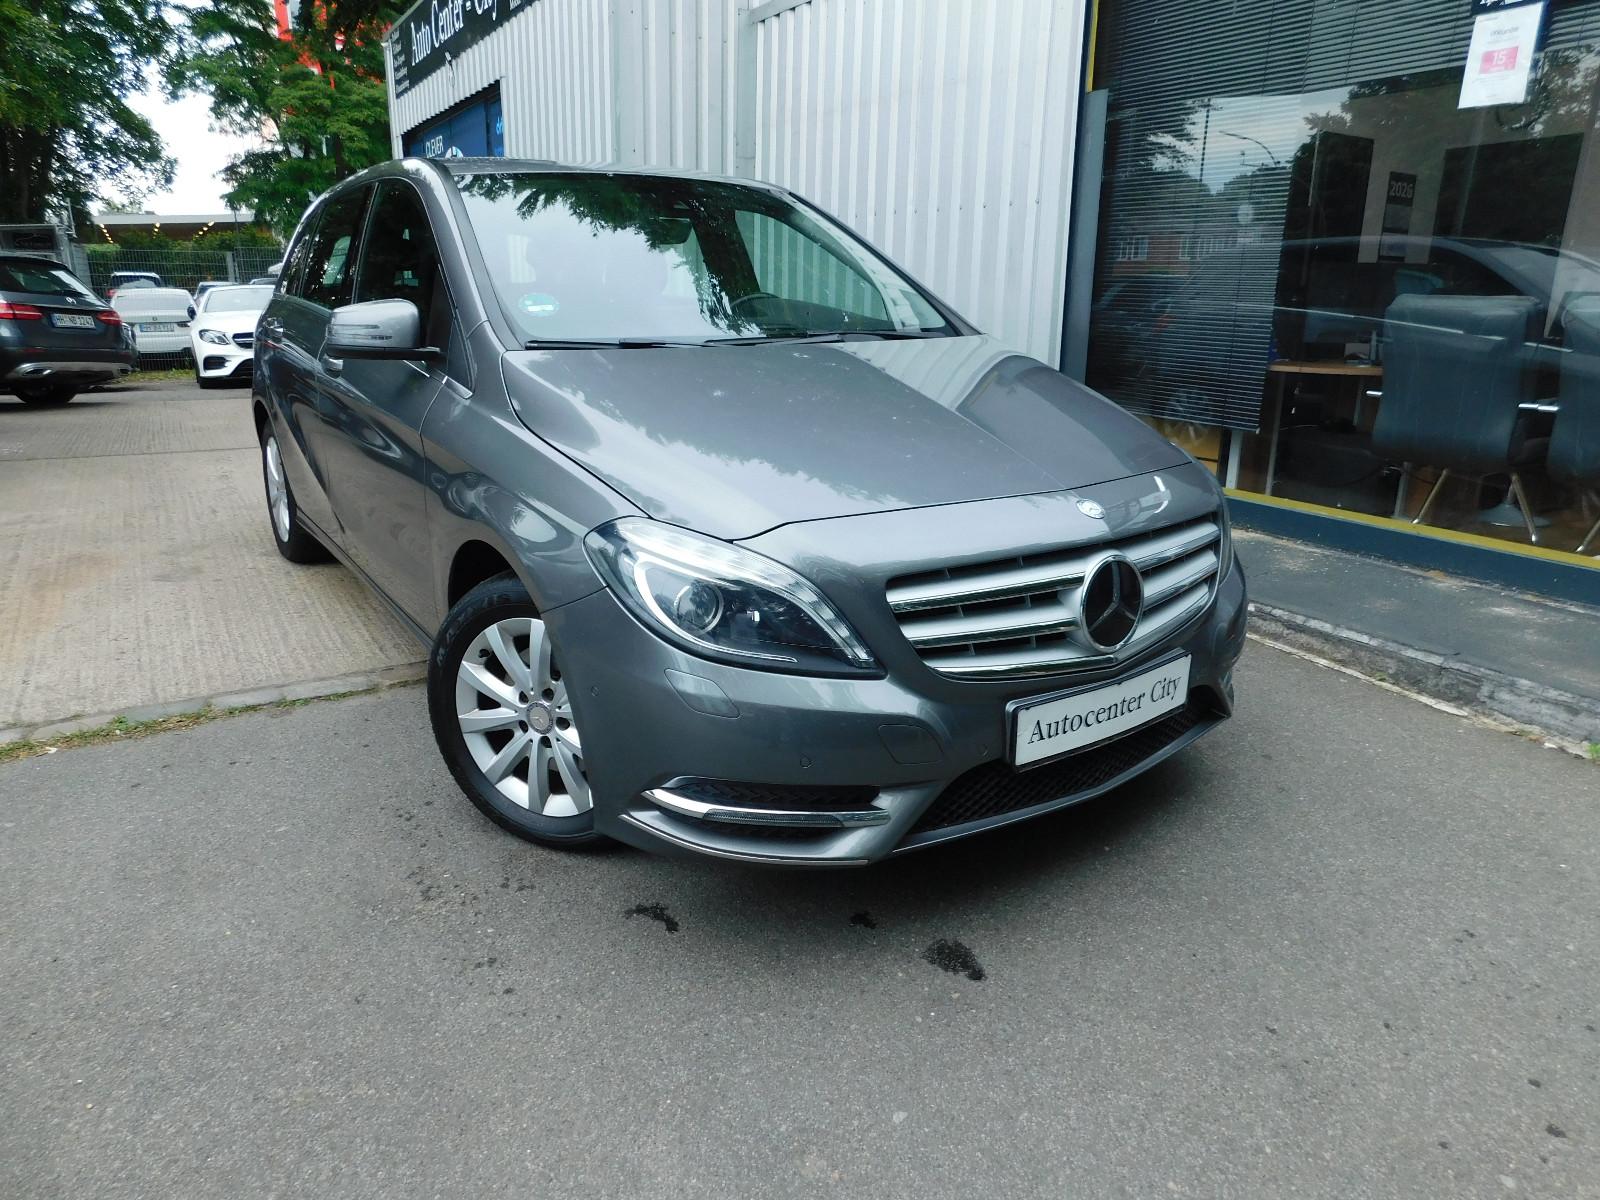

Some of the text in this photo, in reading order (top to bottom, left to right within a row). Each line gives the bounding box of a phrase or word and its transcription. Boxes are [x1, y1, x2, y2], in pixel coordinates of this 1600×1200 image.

[410, 21, 431, 67] Auto
[431, 0, 464, 48] Center
[1490, 50, 1508, 66] 15
[425, 135, 444, 158] CLEVER
[1389, 180, 1413, 199] 2026
[1027, 676, 1182, 745] Autocenter City
